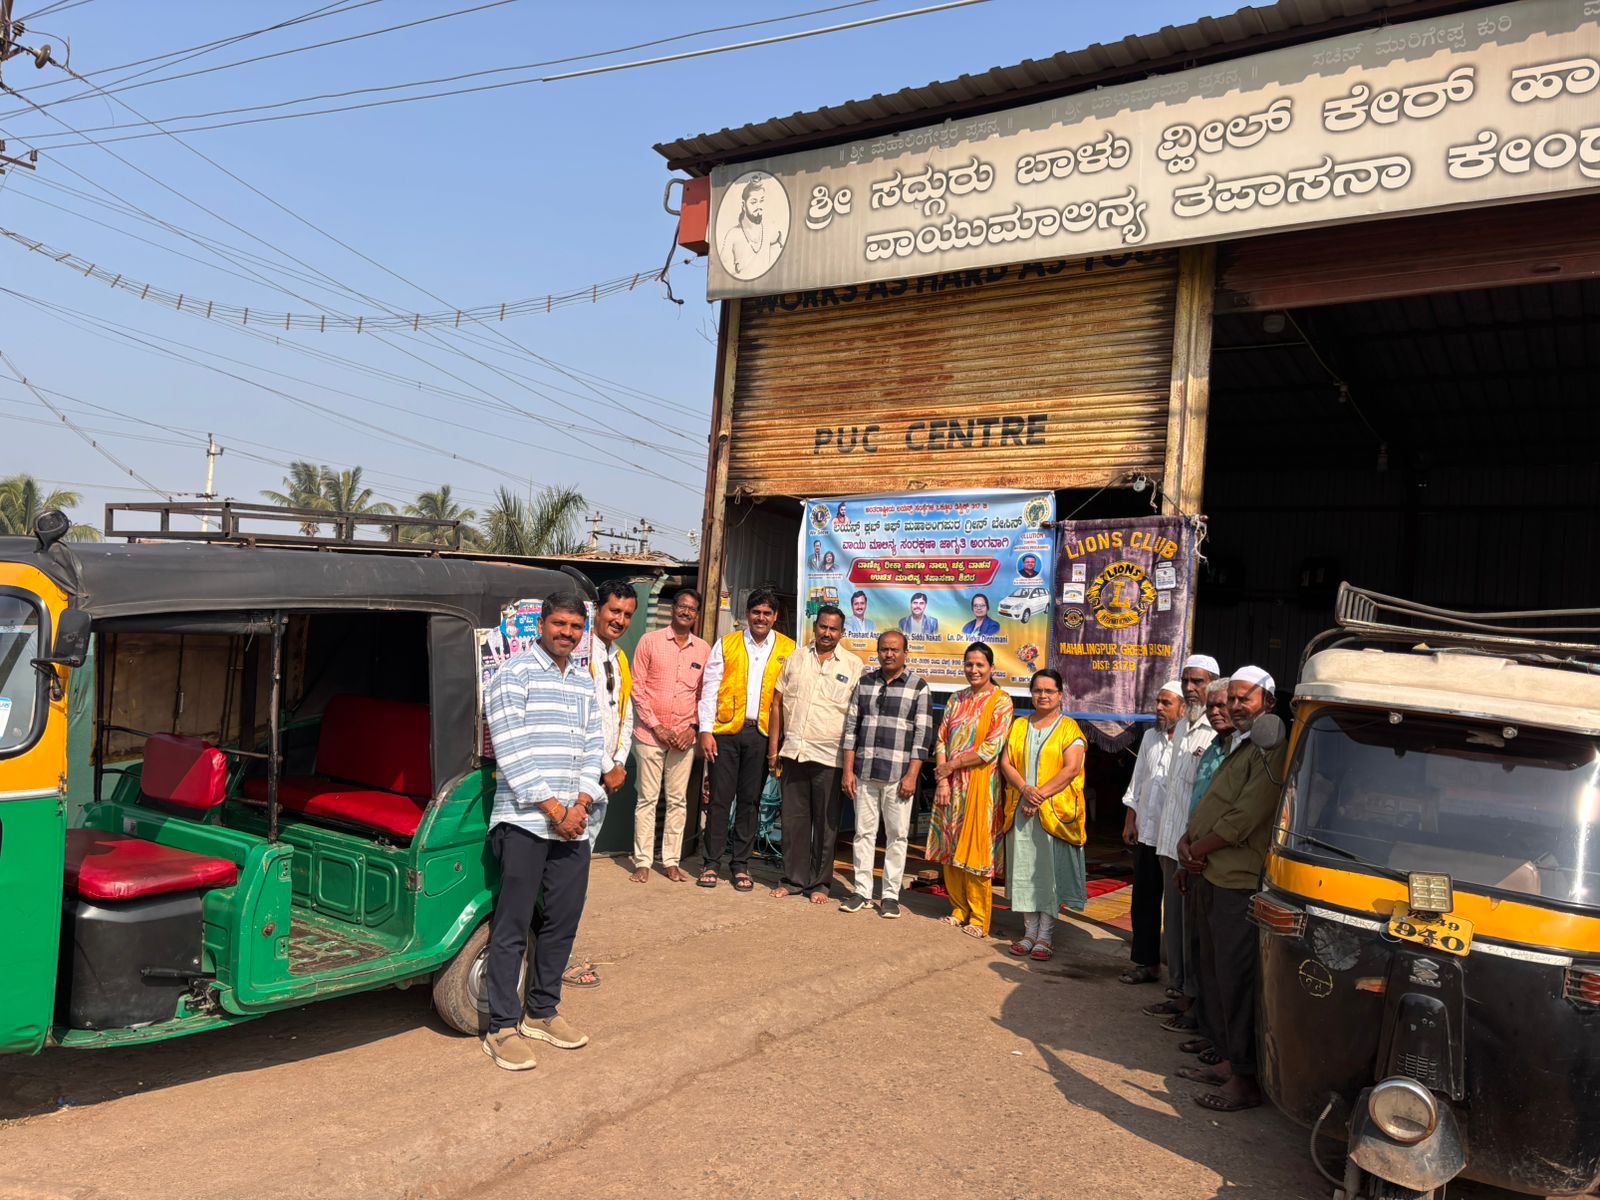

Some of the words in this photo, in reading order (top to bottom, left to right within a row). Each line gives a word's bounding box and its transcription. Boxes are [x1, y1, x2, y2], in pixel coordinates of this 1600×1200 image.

[1477, 15, 1512, 36] ಕುರಿ
[804, 183, 853, 231] ಶ್ರೀ
[870, 156, 995, 216] ಸದ್ಗುರು
[1015, 131, 1132, 185] ಬಾಳು
[1322, 66, 1476, 133] ಕೇರ್
[850, 145, 865, 165] ಶ್ರೀ
[871, 125, 960, 156] ಮಹಾಲಿಂಗೇಶ್ವರ
[965, 118, 1000, 140] ಪ್ರಸನ್ನ
[864, 187, 1148, 262] ವಾಯುಮಾಲಿನ್ಯ
[1172, 154, 1413, 218] ತಪಾಸನಾ
[813, 424, 882, 455] PUC
[904, 413, 1048, 452] CENTRE
[965, 517, 988, 533] ಗ್ರೀನ್
[842, 541, 867, 551] ವಾಯು
[869, 539, 897, 556] ಮಾಲಿನ್ಯ
[970, 537, 1010, 549] ಅಂಗವಾಗಿ
[1065, 531, 1123, 560] LIONS
[1130, 531, 1179, 559] CLUB
[1106, 563, 1141, 578] LIONS
[1109, 581, 1131, 609] L
[848, 631, 869, 639] Prashant
[911, 633, 925, 641] Siddu
[1059, 642, 1118, 656] MAHALINGPUR
[1112, 660, 1137, 672] 317B
[1394, 922, 1465, 952] 940
